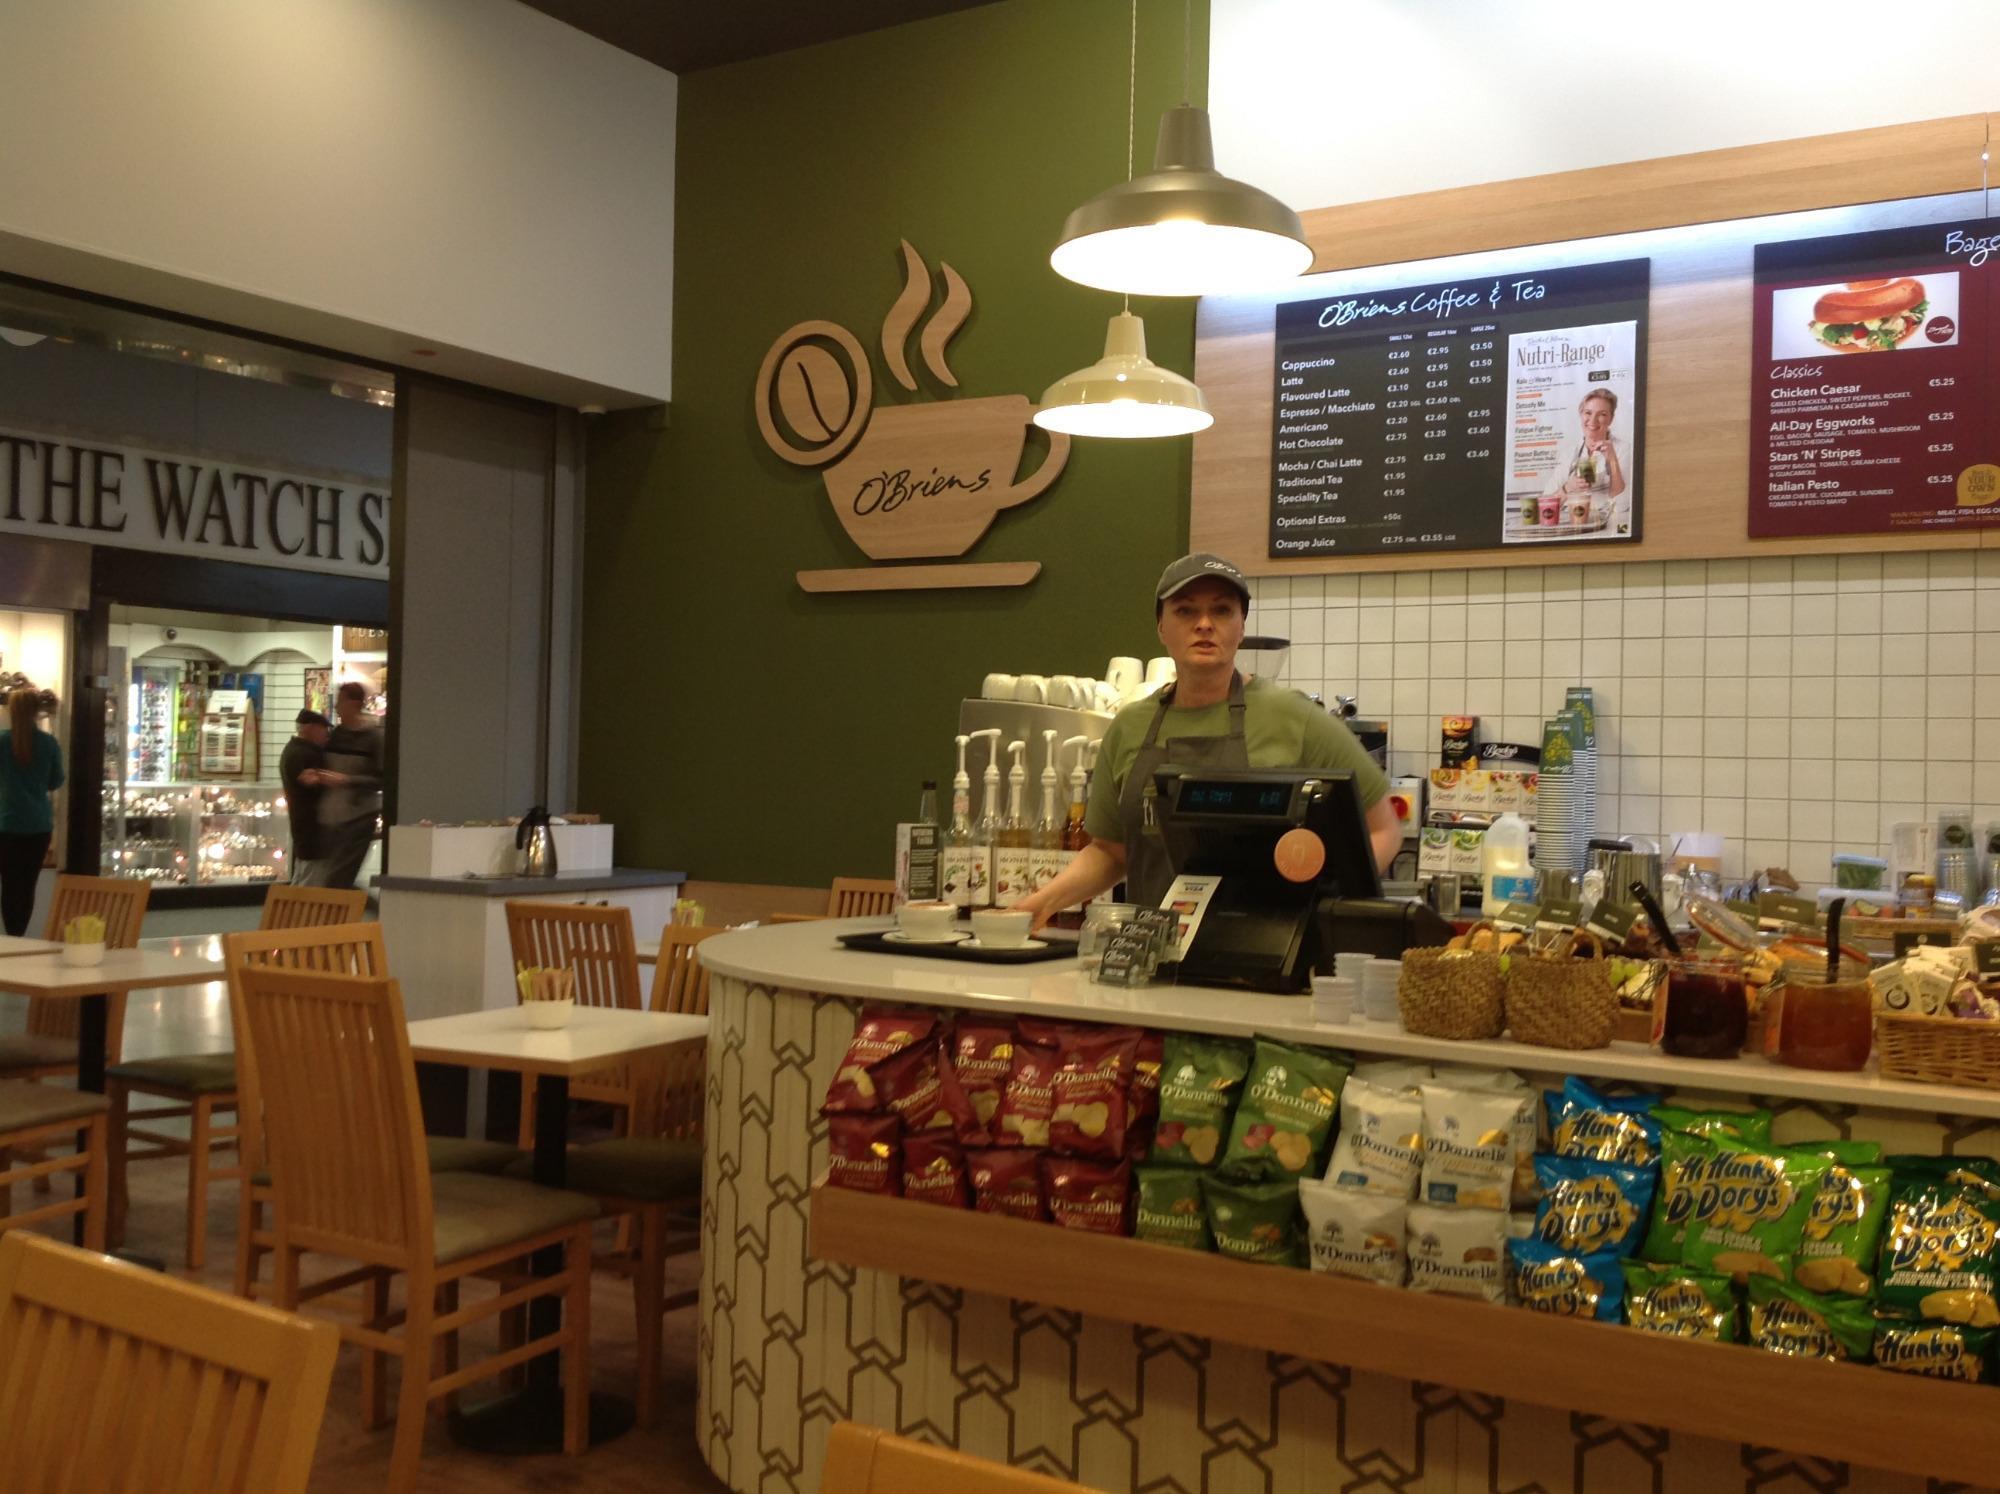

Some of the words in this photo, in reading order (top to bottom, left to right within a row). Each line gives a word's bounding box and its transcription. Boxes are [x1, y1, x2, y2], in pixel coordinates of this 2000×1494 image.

[1318, 299, 1408, 328] O'Briens
[1410, 288, 1480, 318] Coffee
[1489, 281, 1501, 310] &
[1511, 279, 1545, 301] Tea
[1281, 358, 1336, 372] Cappuccino
[1388, 350, 1410, 359] €2.60
[1427, 346, 1450, 355] €2.95
[1470, 341, 1493, 351] €3.50
[1517, 342, 1605, 367] Nutri-Range
[1281, 377, 1304, 386] Latte
[1387, 367, 1409, 376] €2.60
[1426, 363, 1449, 372] €2.95
[1469, 358, 1493, 368] €3.50
[1770, 364, 1824, 380] Classics
[1280, 389, 1325, 402] Flavoured
[1327, 388, 1350, 398] Latte
[1387, 384, 1409, 392] €3.10
[1426, 380, 1448, 388] €3.45
[1469, 376, 1492, 384] €3.95
[1770, 388, 1818, 399] Chicken
[1820, 384, 1861, 395] Caesar
[1929, 377, 1955, 387] €5.25
[1280, 407, 1320, 419] Espresso
[1321, 405, 1327, 415] /
[1327, 402, 1376, 414] Macchiato
[1386, 400, 1409, 408] €2.20
[1425, 396, 1448, 405] €2.60
[1280, 422, 1329, 434] Americano
[1386, 416, 1408, 425] €2.20
[1425, 413, 1447, 422] €2.60
[1468, 409, 1491, 418] €2.95
[1770, 421, 1813, 432] All-Day
[1816, 416, 1875, 431] Eggworks
[1928, 412, 1954, 421] €5.25
[1279, 441, 1296, 449] Hot
[1297, 436, 1344, 448] Chocolate
[1385, 433, 1407, 441] €2.75
[1424, 430, 1447, 438] €3.20
[1467, 426, 1490, 435] €3.60
[1278, 461, 1309, 471] Mocha
[1316, 459, 1338, 469] Chai
[1339, 458, 1363, 468] Latte
[1384, 456, 1407, 464] €2.75
[1423, 453, 1446, 461] €3.20
[1466, 450, 1490, 458] €3.60
[1769, 452, 1799, 462] Stars
[1820, 448, 1862, 460] Stripes
[1927, 443, 1954, 452] €5.25
[853, 467, 992, 516] O'Briens
[1278, 475, 1326, 487] Traditional
[1326, 475, 1343, 484] Tea
[1384, 472, 1406, 480] €1.95
[1769, 481, 1805, 492] Italian
[1807, 480, 1840, 490] Pesto
[1927, 475, 1953, 484] €5.25
[0, 434, 128, 533] THE
[143, 458, 344, 561] WATCH
[357, 490, 390, 567] S
[1277, 493, 1321, 505] Speciality
[1322, 491, 1338, 500] Tea
[1383, 488, 1406, 496] €1.95
[1276, 515, 1317, 528] Optional
[1318, 515, 1346, 524] Extras
[1275, 539, 1310, 550] Orange
[1311, 537, 1336, 547] Juice
[1382, 535, 1404, 544] €2.75
[1052, 1066, 1118, 1084] O'Donnells
[1161, 1083, 1228, 1107] O'Donnells
[1251, 1084, 1332, 1120] O'Donnells
[1426, 1138, 1506, 1162] O'Donnells
[1706, 1151, 1778, 1187] Hunky
[1552, 1179, 1618, 1209] Hunky
[1695, 1180, 1779, 1221] Dorys
[1541, 1210, 1622, 1243] Dorys
[1411, 1257, 1498, 1280] O'Donnells
[1520, 1262, 1581, 1289] Hunky
[1879, 1330, 1961, 1365] Hunky
